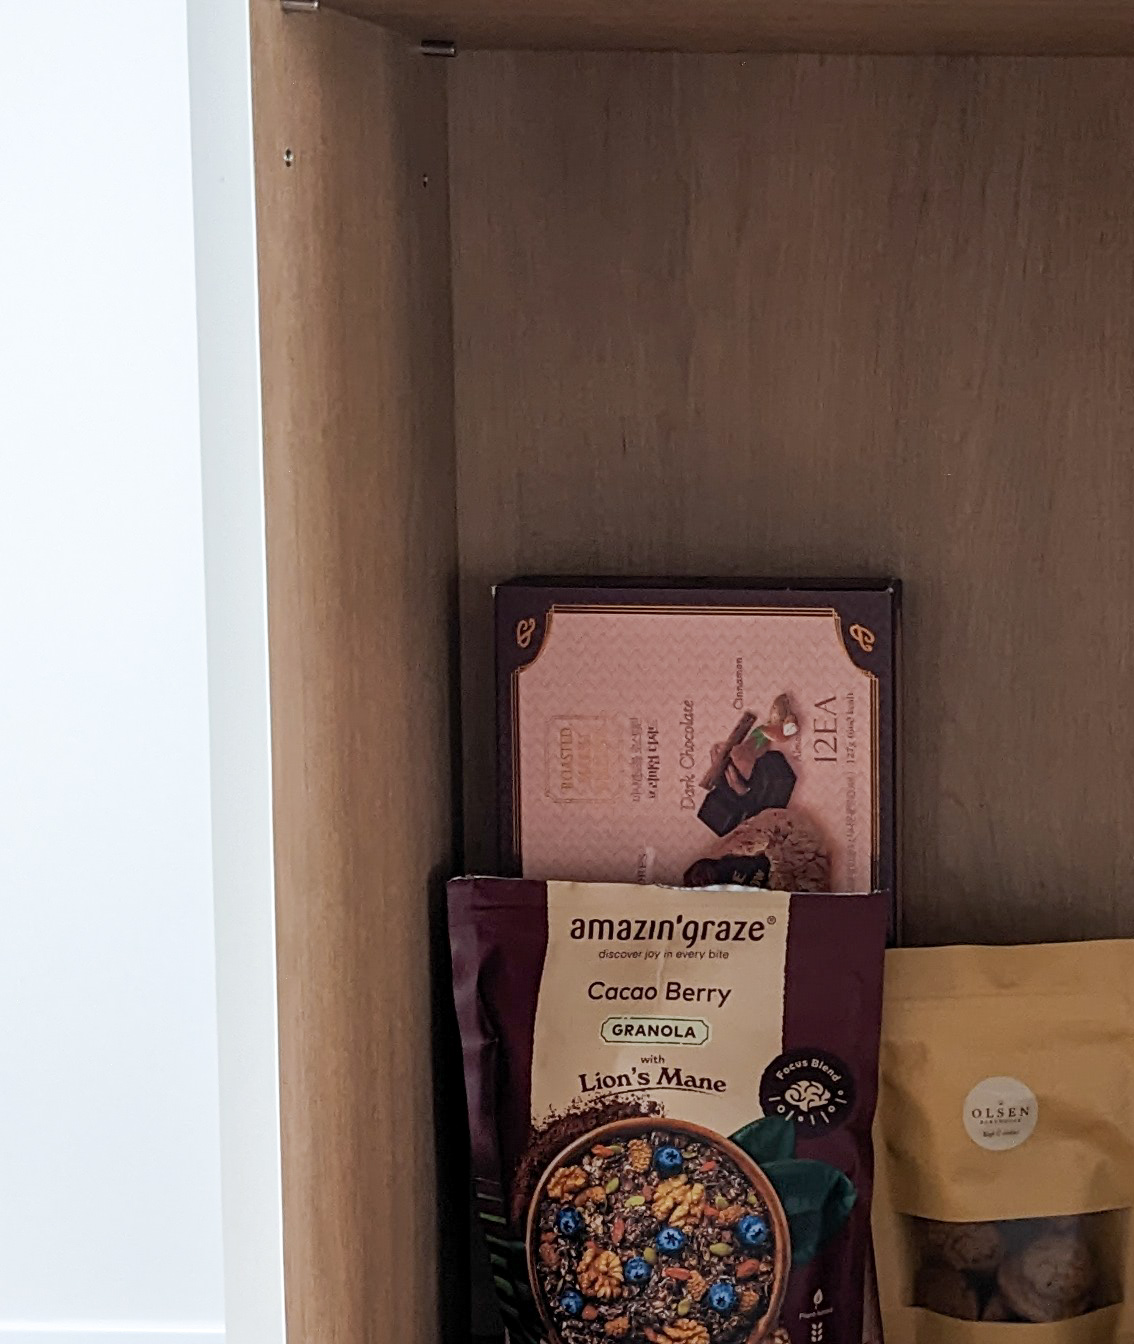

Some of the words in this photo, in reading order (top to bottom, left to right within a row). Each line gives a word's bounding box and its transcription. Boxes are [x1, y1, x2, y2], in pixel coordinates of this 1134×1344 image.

[733, 657, 744, 710] Cinnamon
[679, 699, 695, 770] Chocolate
[813, 695, 838, 763] 12EA
[679, 774, 696, 810] Dark
[598, 949, 642, 959] discover
[644, 949, 659, 960] joy
[663, 950, 673, 959] in
[675, 951, 705, 960] every
[708, 949, 729, 959] bite
[588, 981, 658, 1000] Cacao
[665, 981, 732, 1007] Berry
[612, 1023, 697, 1039] GRANOLA
[640, 1054, 665, 1064] with
[776, 1059, 809, 1080] Focus
[810, 1058, 842, 1082] Blend
[578, 1067, 650, 1092] Lion's
[656, 1067, 727, 1092] Mane
[971, 1106, 1030, 1119] OLSEN
